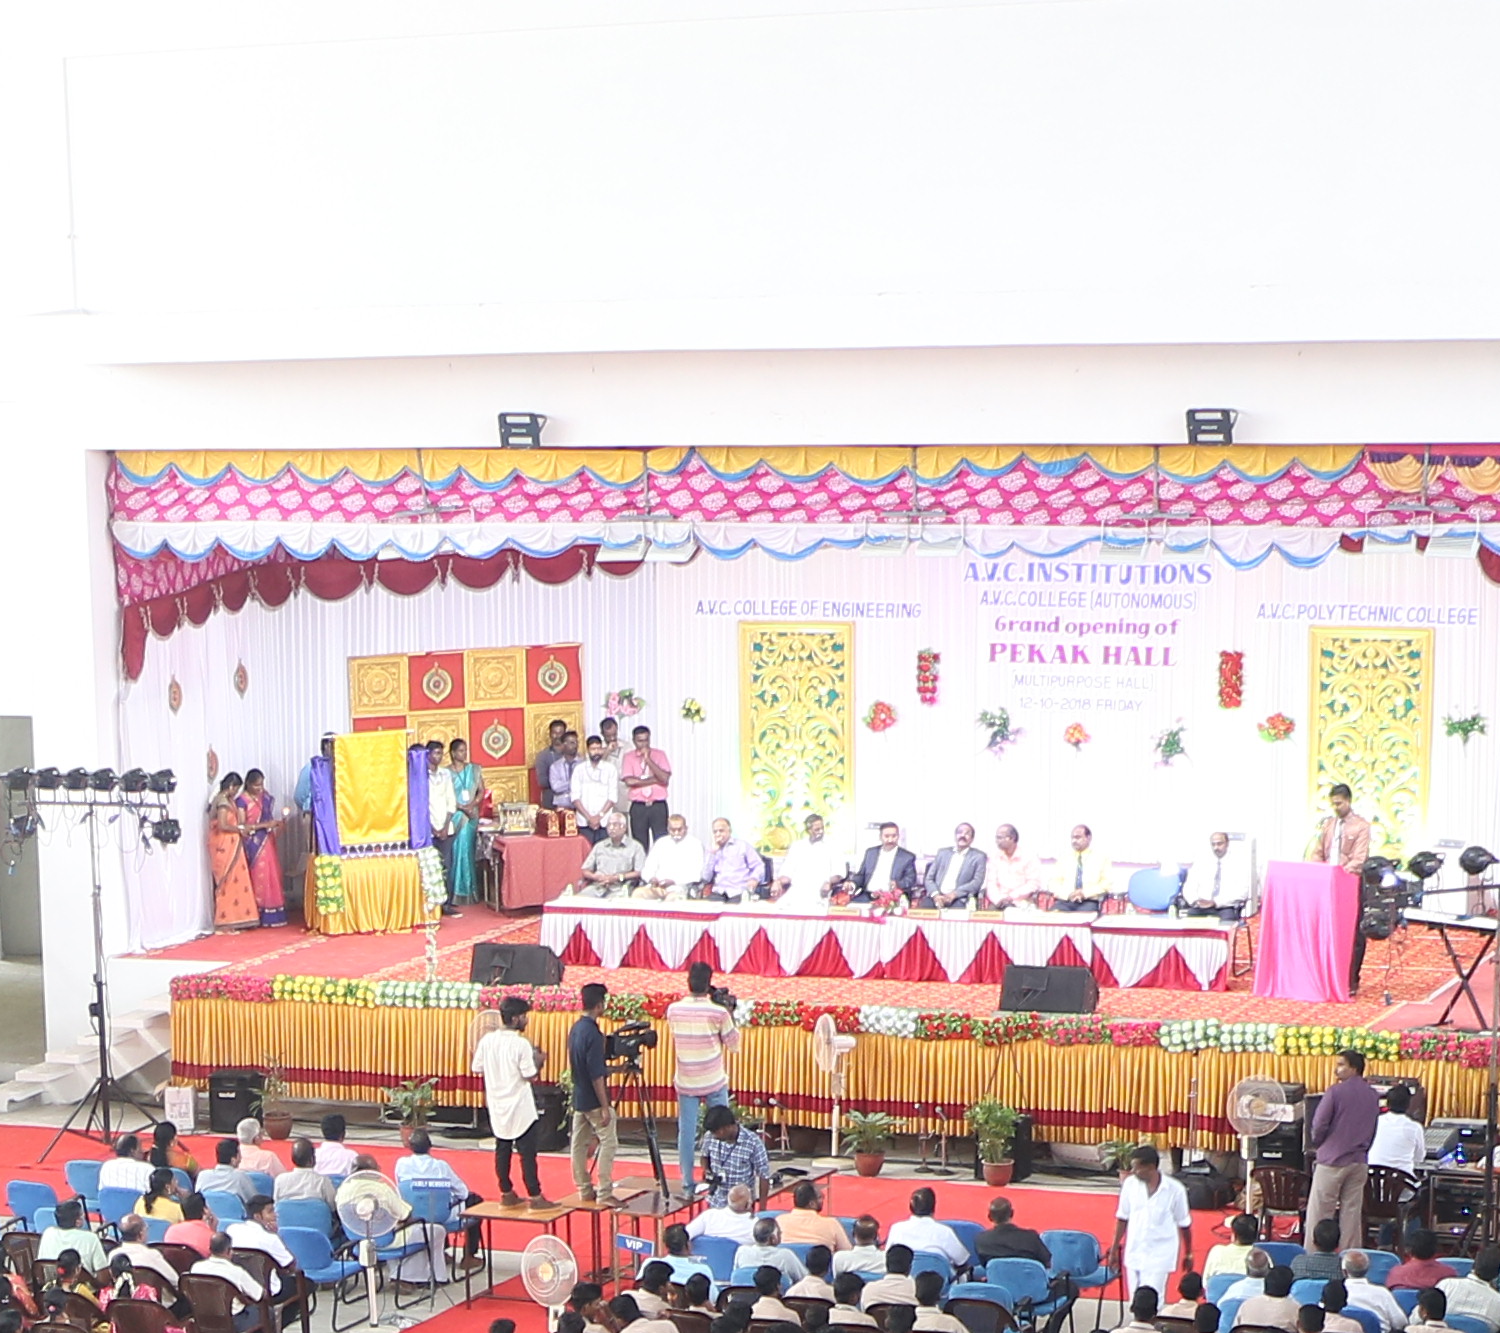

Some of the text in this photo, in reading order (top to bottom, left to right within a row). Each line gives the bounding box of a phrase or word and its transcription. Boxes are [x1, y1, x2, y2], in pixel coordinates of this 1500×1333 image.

[801, 600, 821, 616] OF
[822, 601, 922, 619] ENGINEERING
[1090, 591, 1197, 611] (AUTONOMOUS)
[1406, 606, 1479, 625] COLLEGE
[994, 616, 1182, 639] Grand opening of
[988, 642, 1178, 667] PEKAK HALL
[1019, 697, 1143, 712] 12-10-2018 FRIDAY
[625, 1238, 644, 1250] VIP
